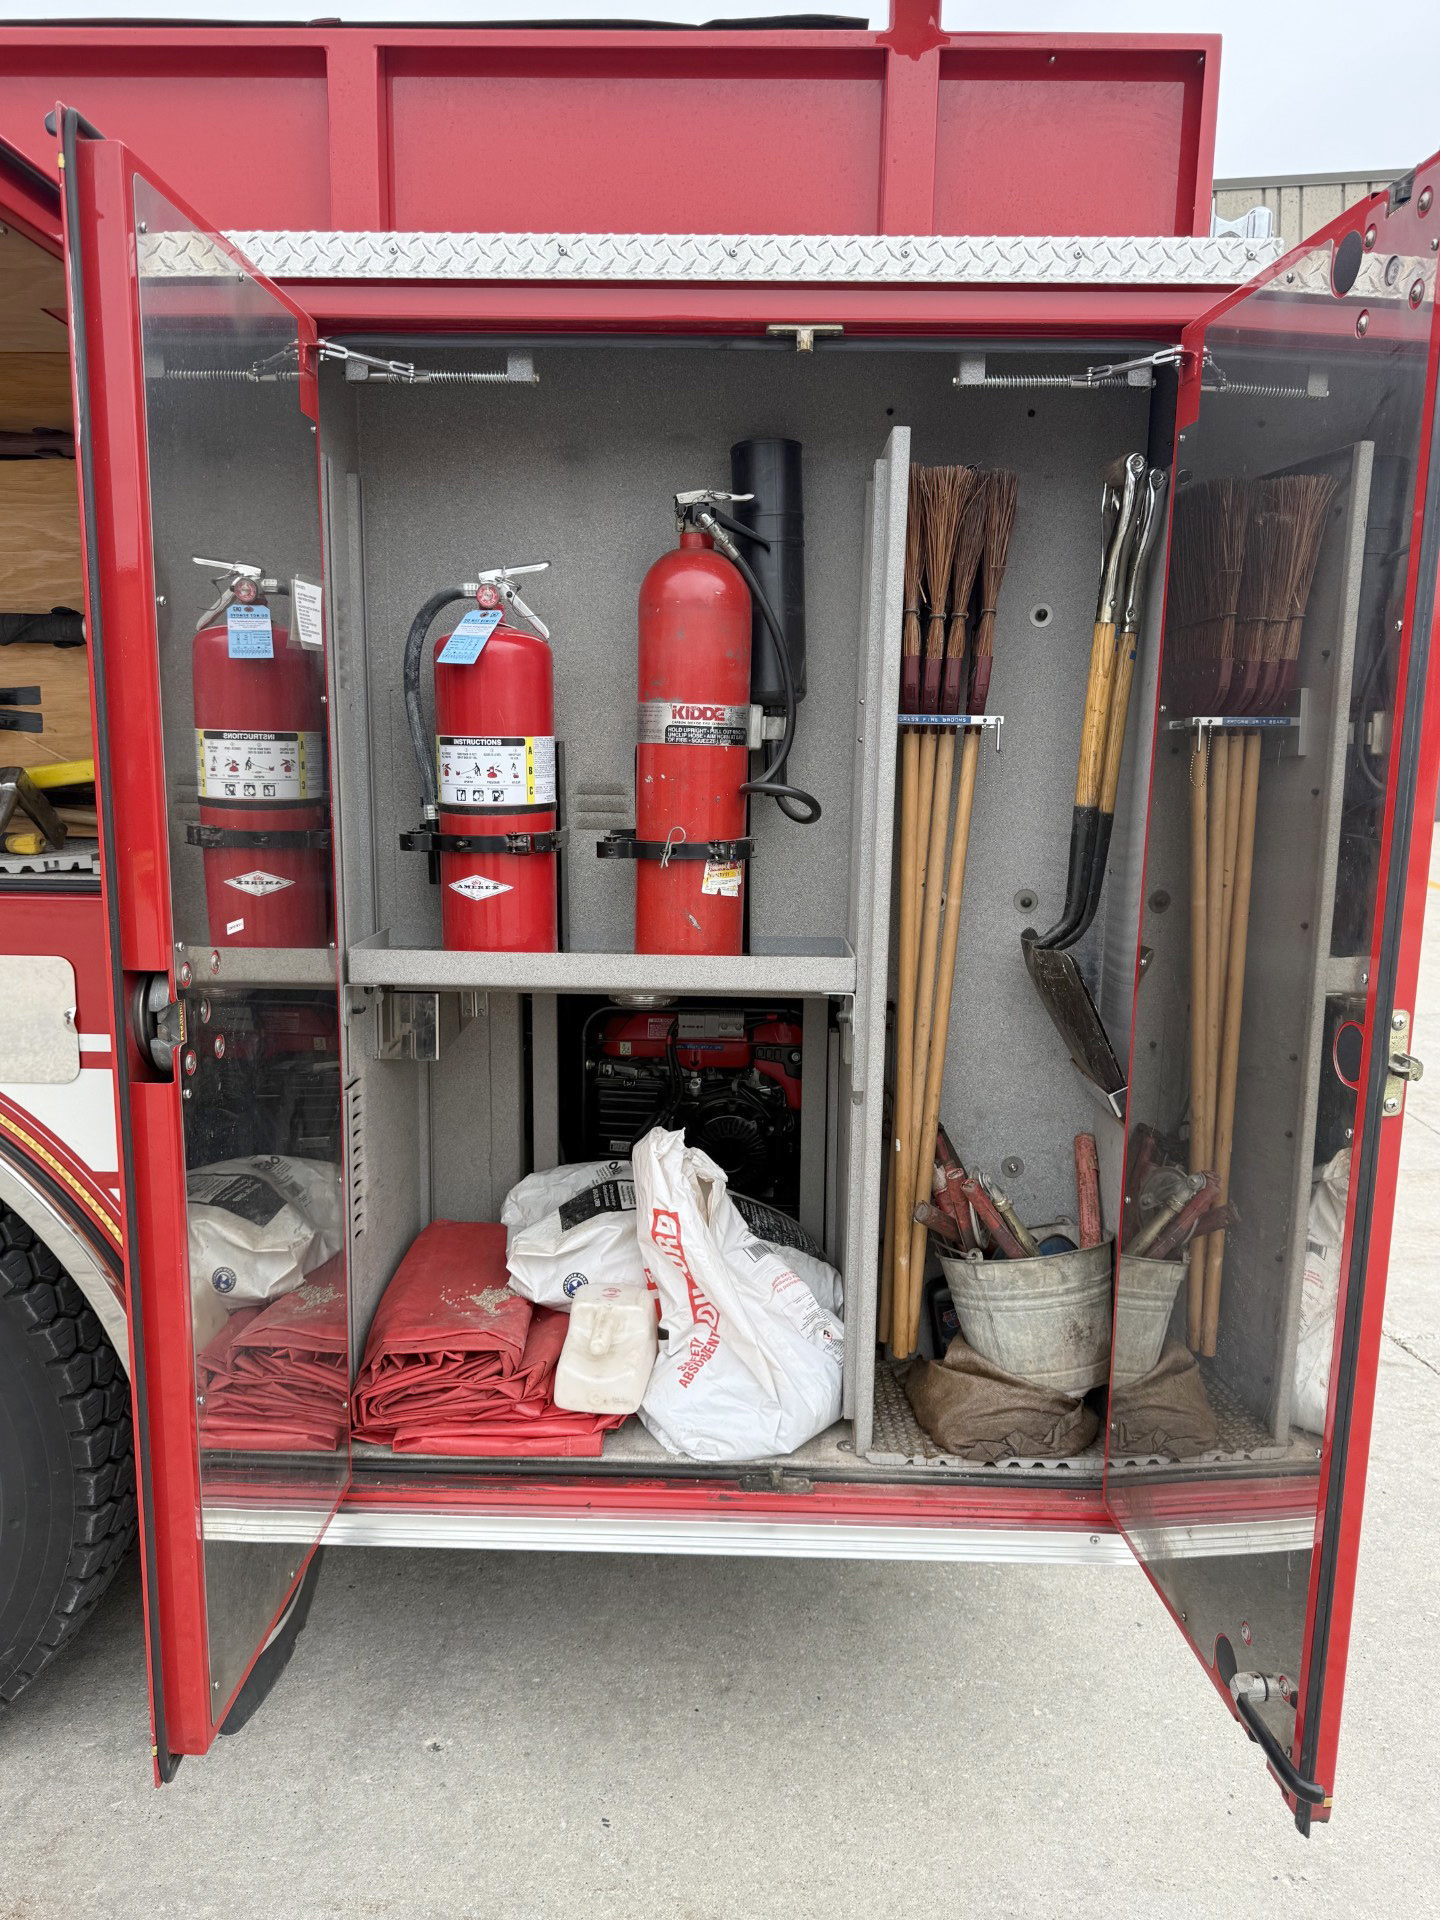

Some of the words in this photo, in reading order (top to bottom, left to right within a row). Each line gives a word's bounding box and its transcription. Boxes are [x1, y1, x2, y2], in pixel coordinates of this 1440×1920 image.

[672, 705, 726, 721] KIDDE
[528, 746, 532, 755] A
[529, 766, 532, 775] B
[529, 787, 533, 795] C
[677, 1336, 704, 1372] SAFETY
